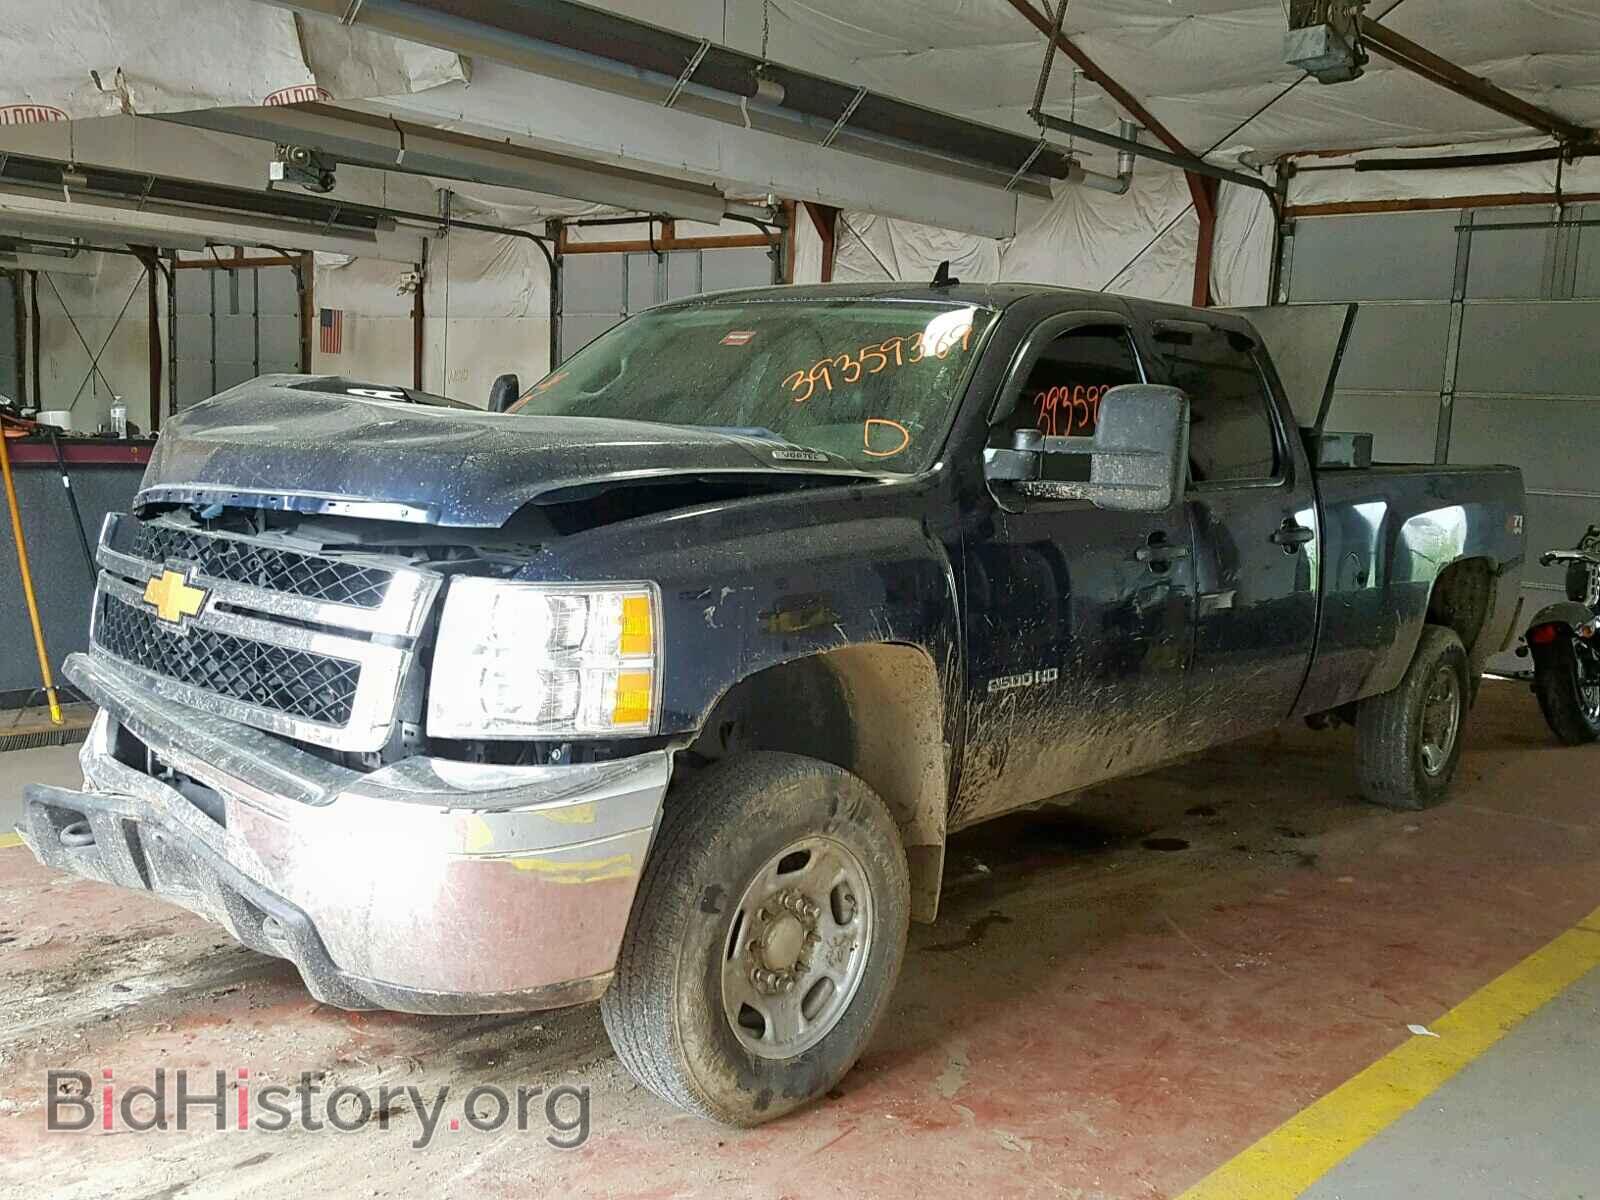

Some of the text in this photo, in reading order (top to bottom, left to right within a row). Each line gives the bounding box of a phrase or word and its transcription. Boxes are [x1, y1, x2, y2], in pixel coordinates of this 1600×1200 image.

[780, 324, 973, 403] 39359369
[1032, 384, 1110, 437] 39359
[863, 418, 909, 457] D
